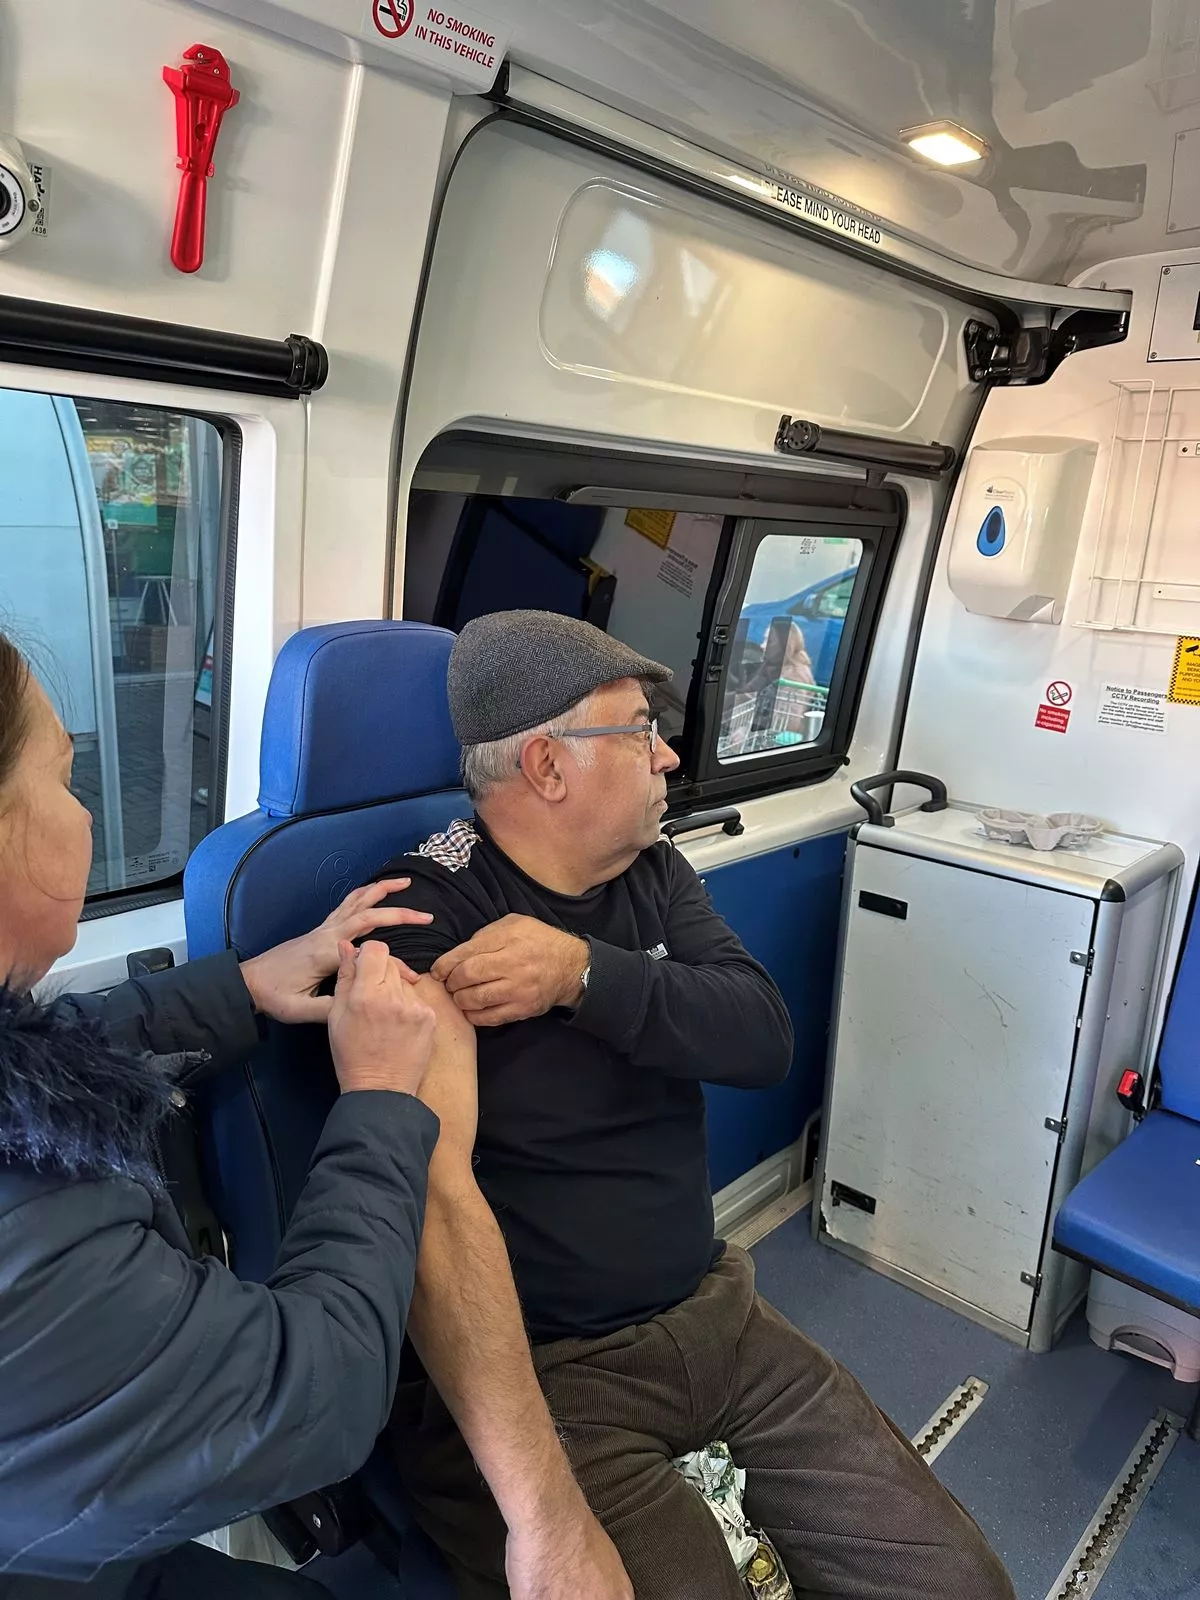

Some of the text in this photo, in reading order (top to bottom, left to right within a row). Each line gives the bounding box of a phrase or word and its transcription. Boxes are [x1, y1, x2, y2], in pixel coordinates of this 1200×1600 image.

[415, 25, 494, 68] IN THIS VEHICLE
[427, 8, 495, 48] NO SMOKING
[804, 198, 829, 222] MIND
[831, 209, 857, 234] YOUR
[857, 222, 881, 245] HEAD
[1128, 696, 1160, 704] Recording
[1133, 689, 1168, 699] Passengers
